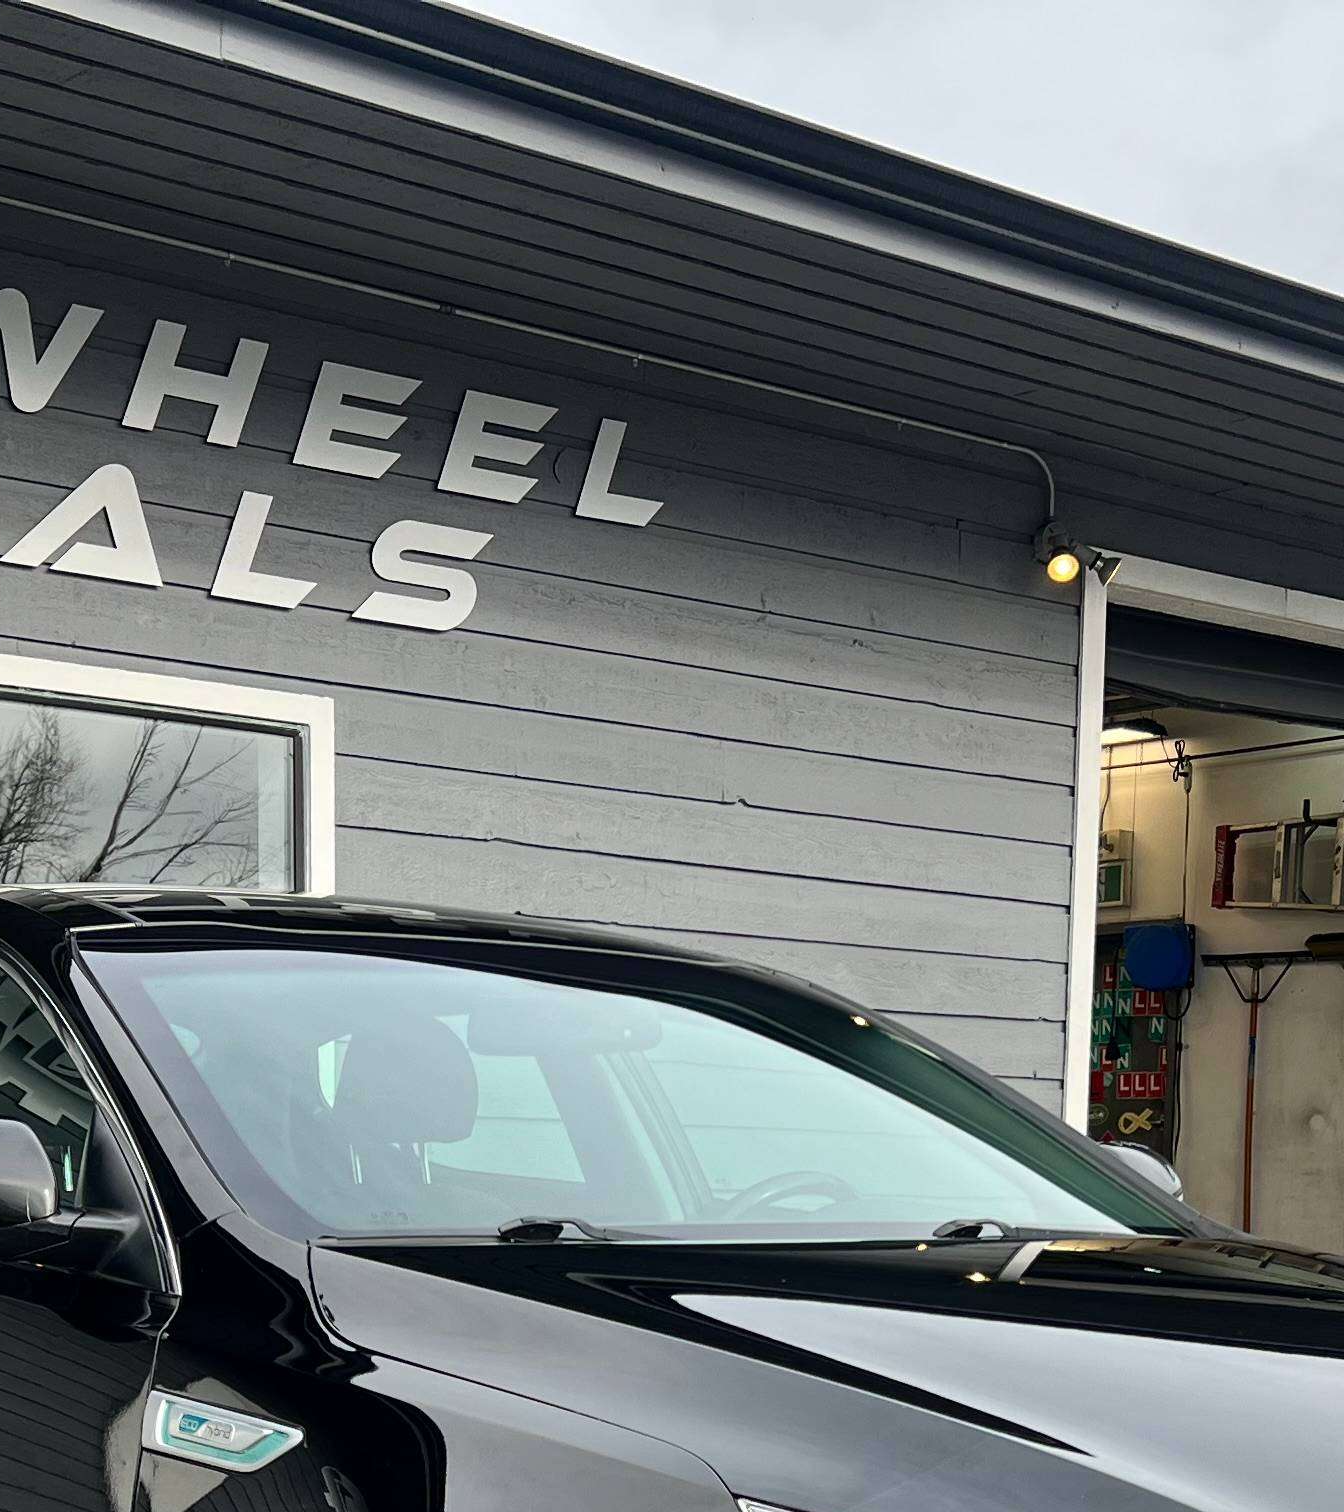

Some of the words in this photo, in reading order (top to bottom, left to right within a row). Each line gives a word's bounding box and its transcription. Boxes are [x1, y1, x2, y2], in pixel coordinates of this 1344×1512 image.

[1105, 965, 1114, 982] L
[1118, 998, 1131, 1014] N
[1134, 991, 1145, 1007] L
[1150, 991, 1160, 1007] L
[1151, 1017, 1164, 1034] N
[1102, 1048, 1111, 1064] L
[1117, 1052, 1129, 1069] N
[1120, 1074, 1130, 1091] L
[1135, 1074, 1145, 1091] L
[1150, 1074, 1161, 1091] L
